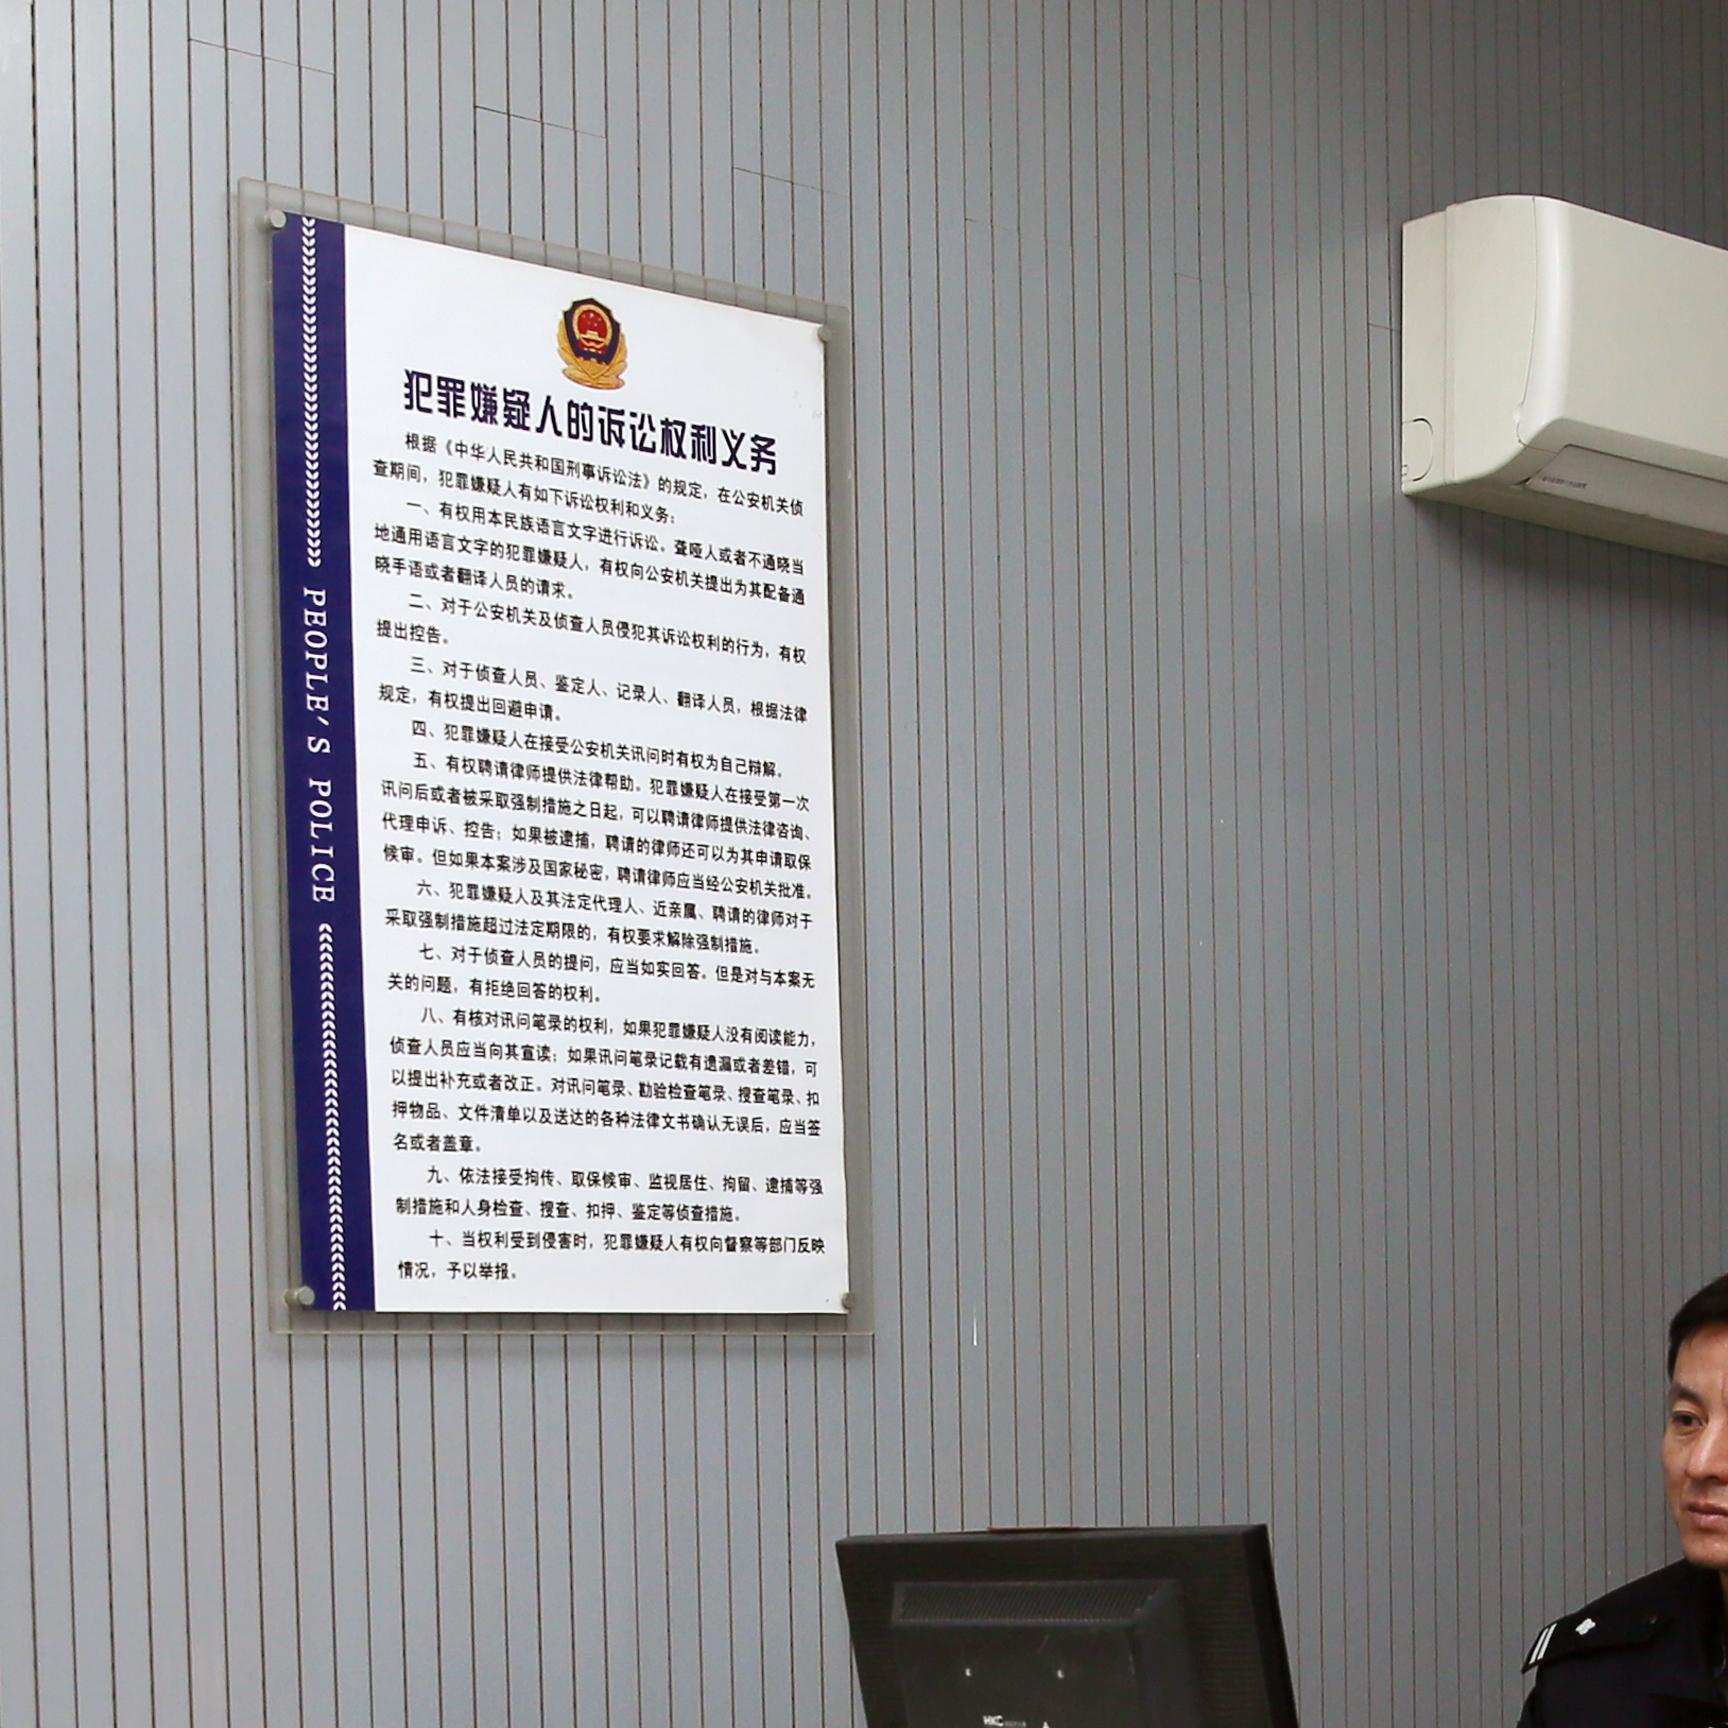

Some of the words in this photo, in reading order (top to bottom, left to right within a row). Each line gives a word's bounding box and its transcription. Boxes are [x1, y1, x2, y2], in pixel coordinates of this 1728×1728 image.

[404, 369, 776, 475] 犯罪嫌疑人的诉讼权利义务
[377, 619, 448, 644] 提出控告。
[308, 777, 336, 904] POLICE
